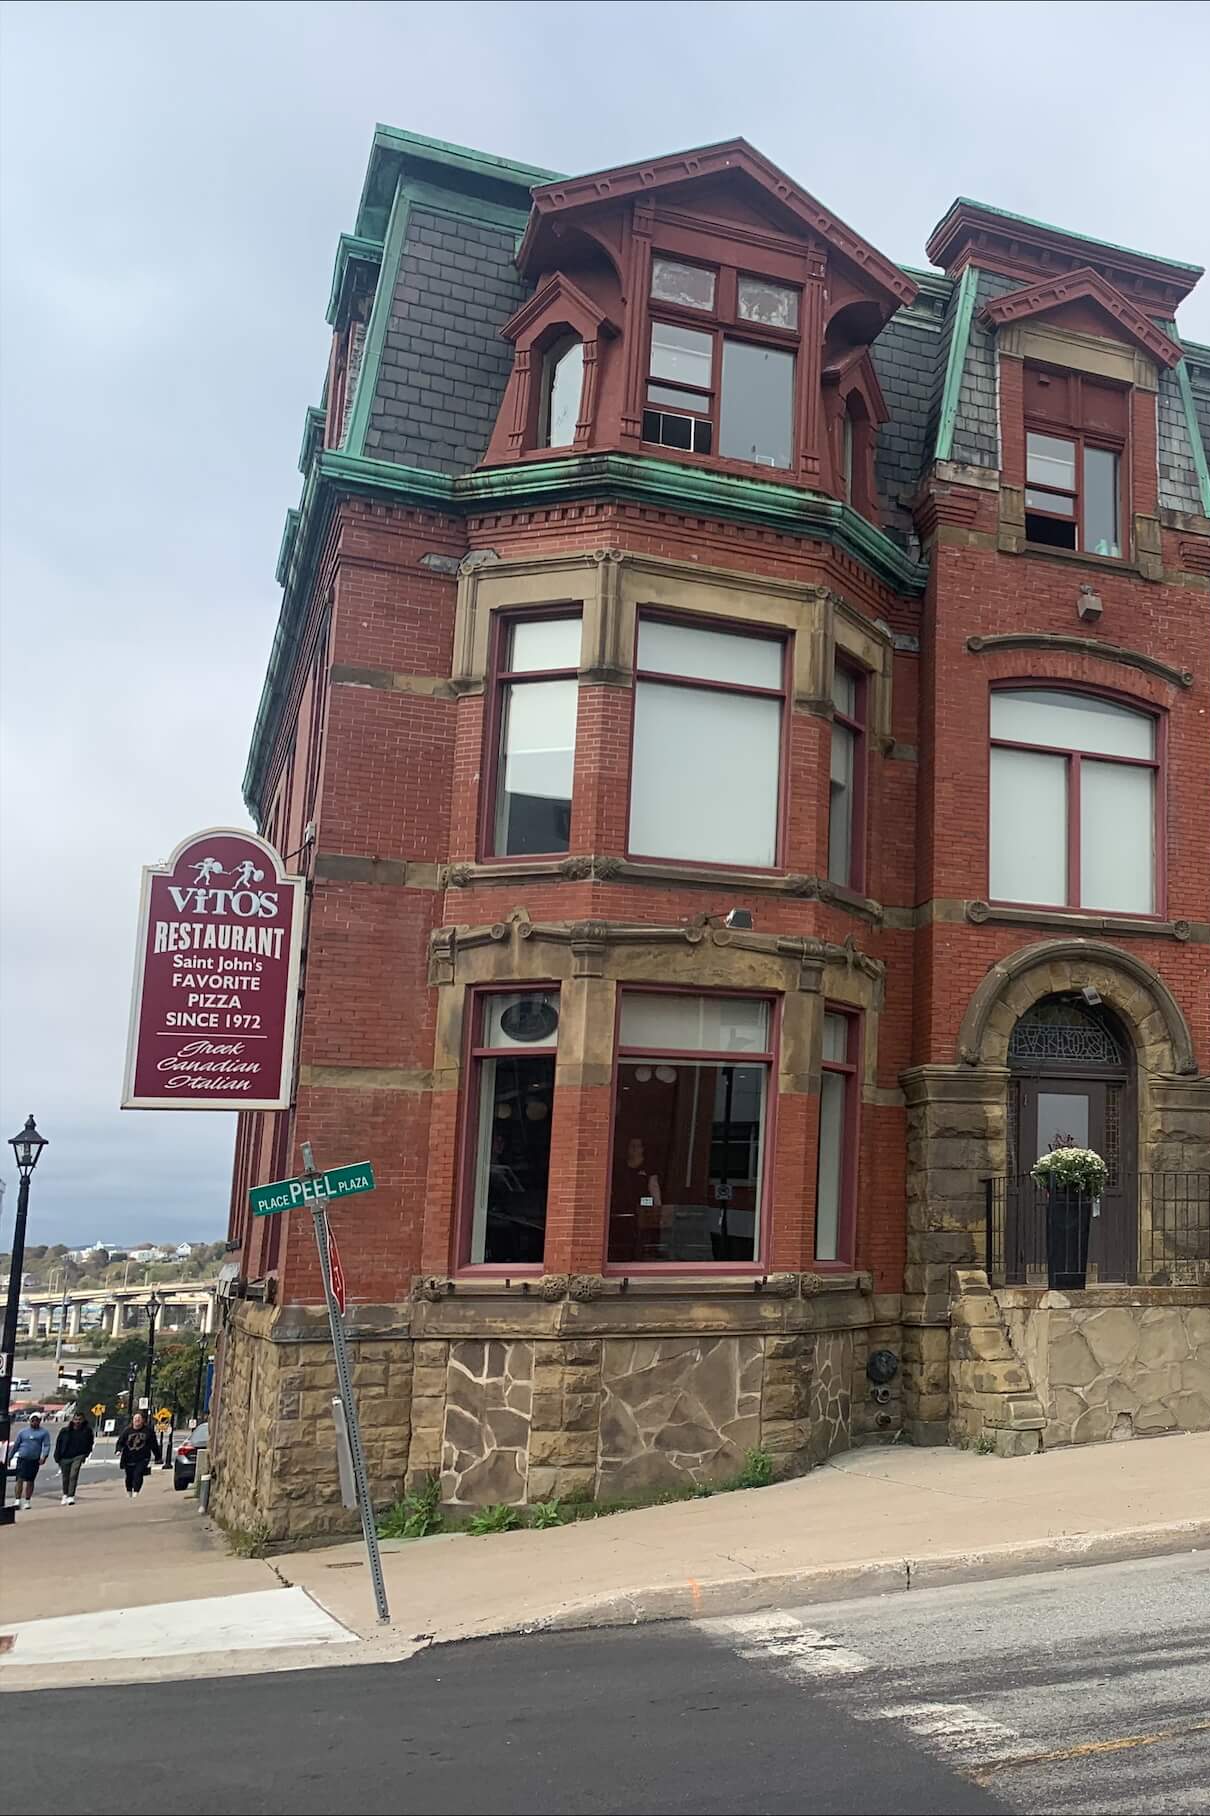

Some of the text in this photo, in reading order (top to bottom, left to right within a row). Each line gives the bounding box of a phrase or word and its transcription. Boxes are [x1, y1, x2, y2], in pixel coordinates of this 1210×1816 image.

[154, 921, 285, 960] RESTAURANT
[172, 954, 263, 973] Saint John's
[172, 973, 261, 990] FAVORITE
[188, 993, 242, 1009] PIZZA
[166, 1012, 261, 1029] SINCE 1972
[177, 1040, 246, 1058] Greek
[157, 1057, 262, 1073] Canadian
[164, 1075, 252, 1091] Italian
[258, 1176, 369, 1211] PLACE PEEL PLAZA
